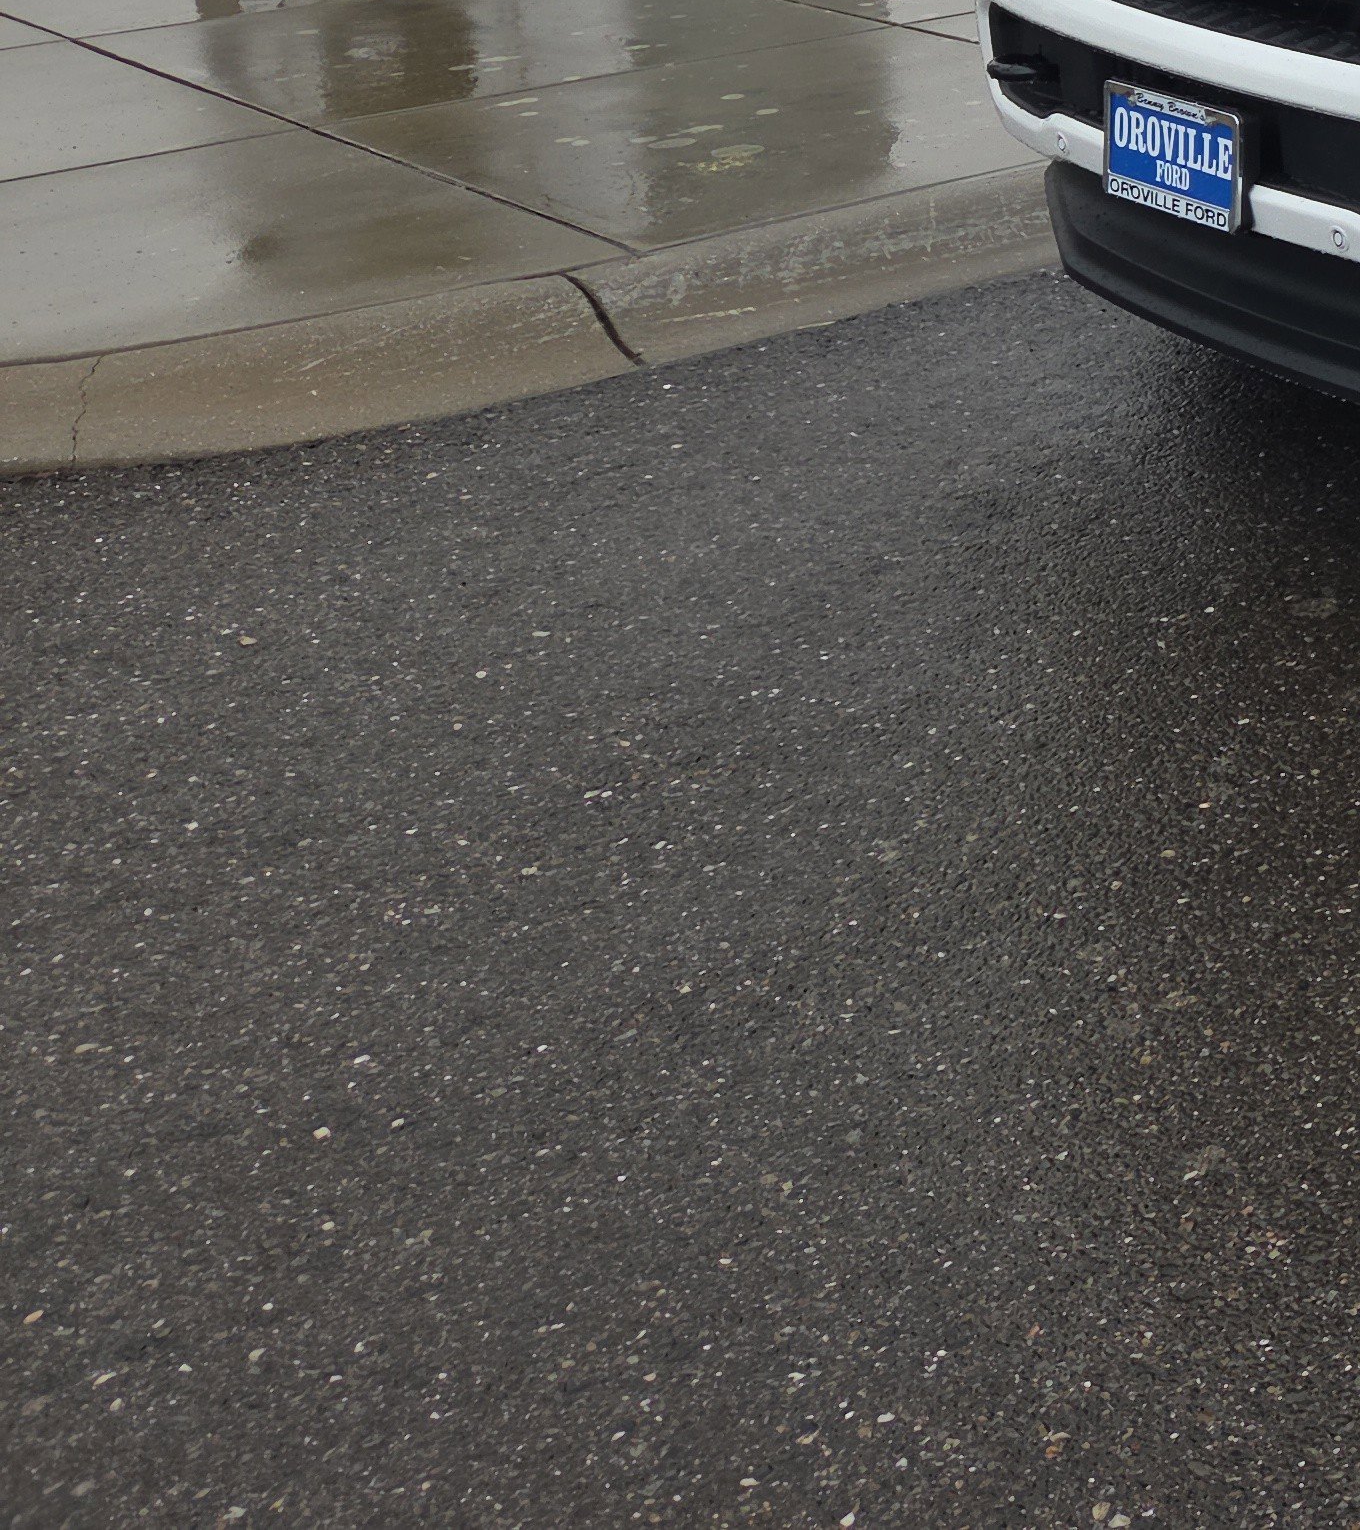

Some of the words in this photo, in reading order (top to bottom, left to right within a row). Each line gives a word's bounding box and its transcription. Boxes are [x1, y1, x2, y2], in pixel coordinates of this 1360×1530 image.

[1114, 106, 1233, 181] OROVILLE
[1155, 159, 1190, 191] FORD
[1110, 178, 1181, 214] OROVILLE
[1184, 202, 1227, 229] FORD
